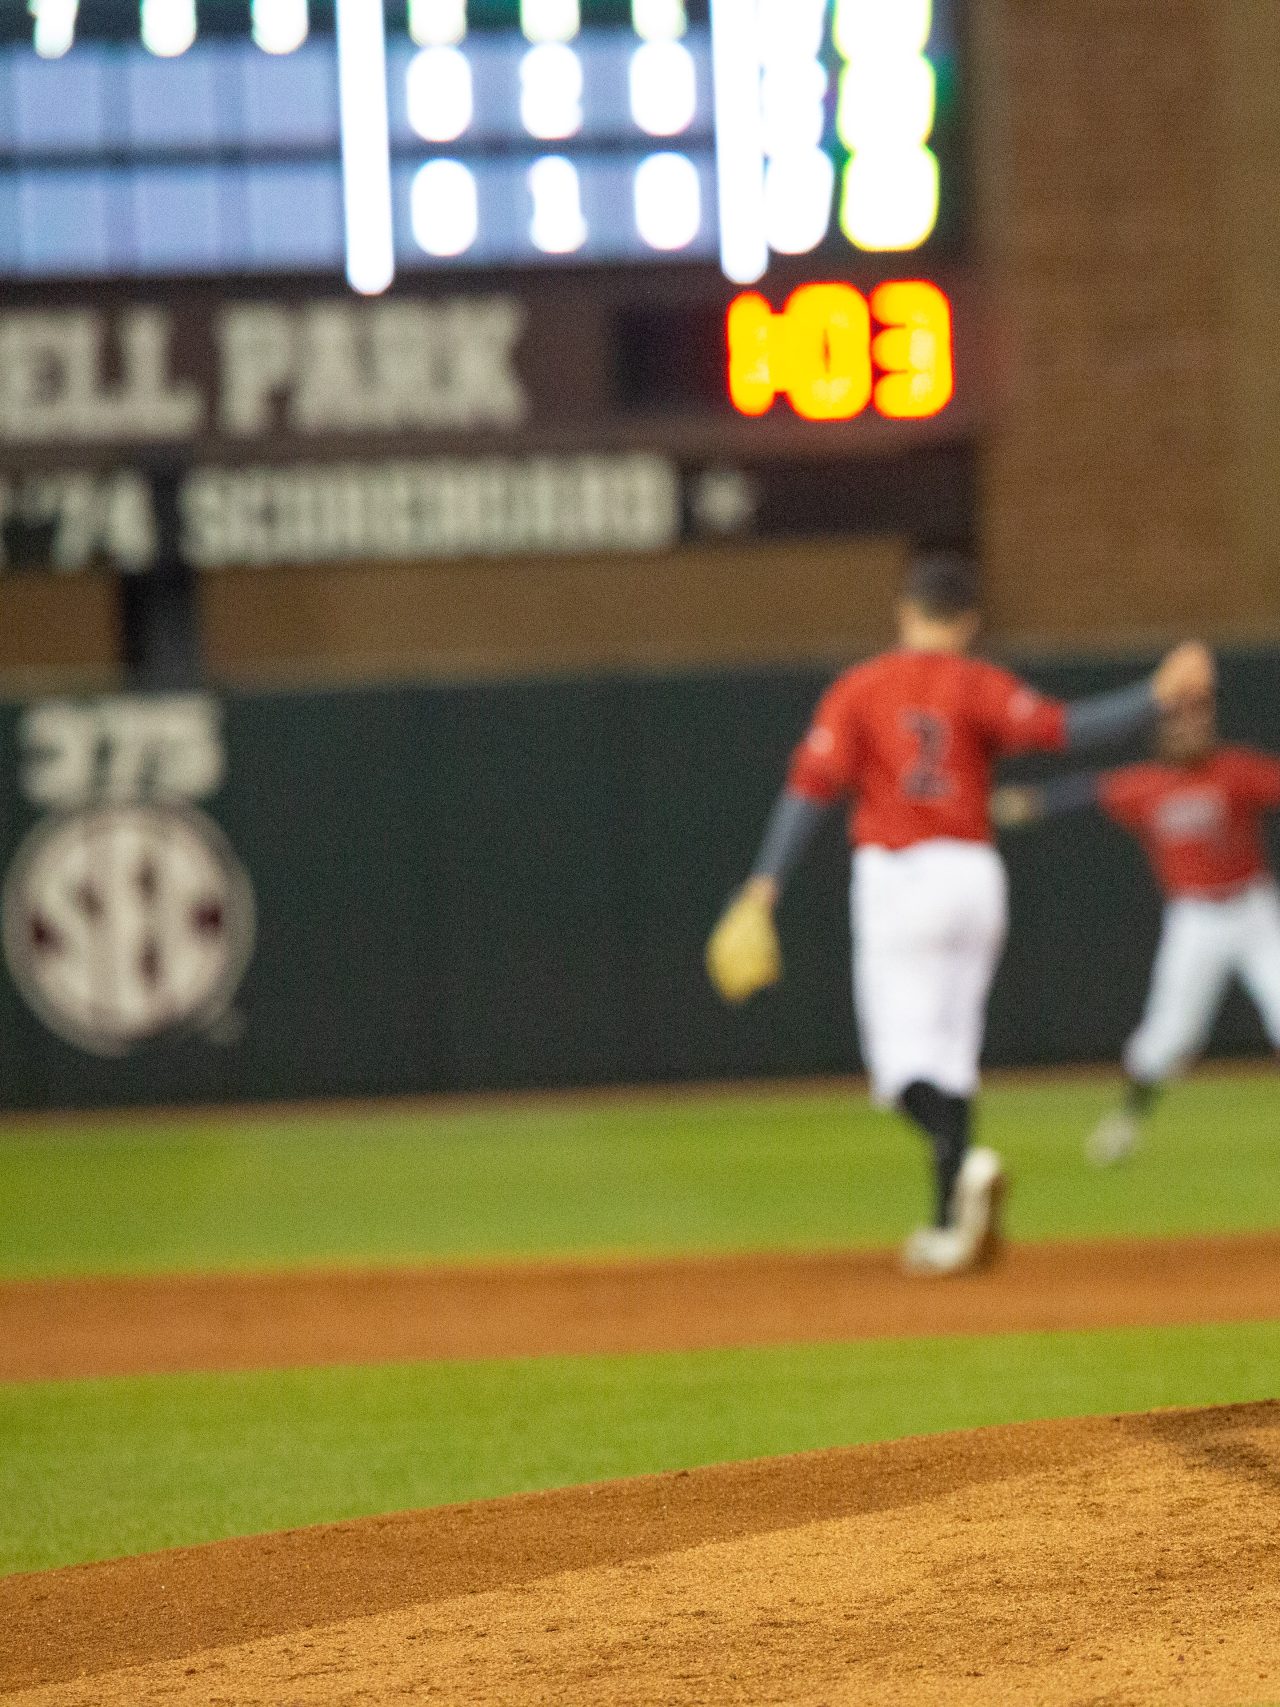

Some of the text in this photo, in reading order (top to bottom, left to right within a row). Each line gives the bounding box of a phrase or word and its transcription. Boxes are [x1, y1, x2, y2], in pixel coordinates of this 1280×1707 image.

[218, 298, 526, 436] PARK
[182, 452, 679, 569] SCOREBOARD
[17, 697, 227, 803] 375
